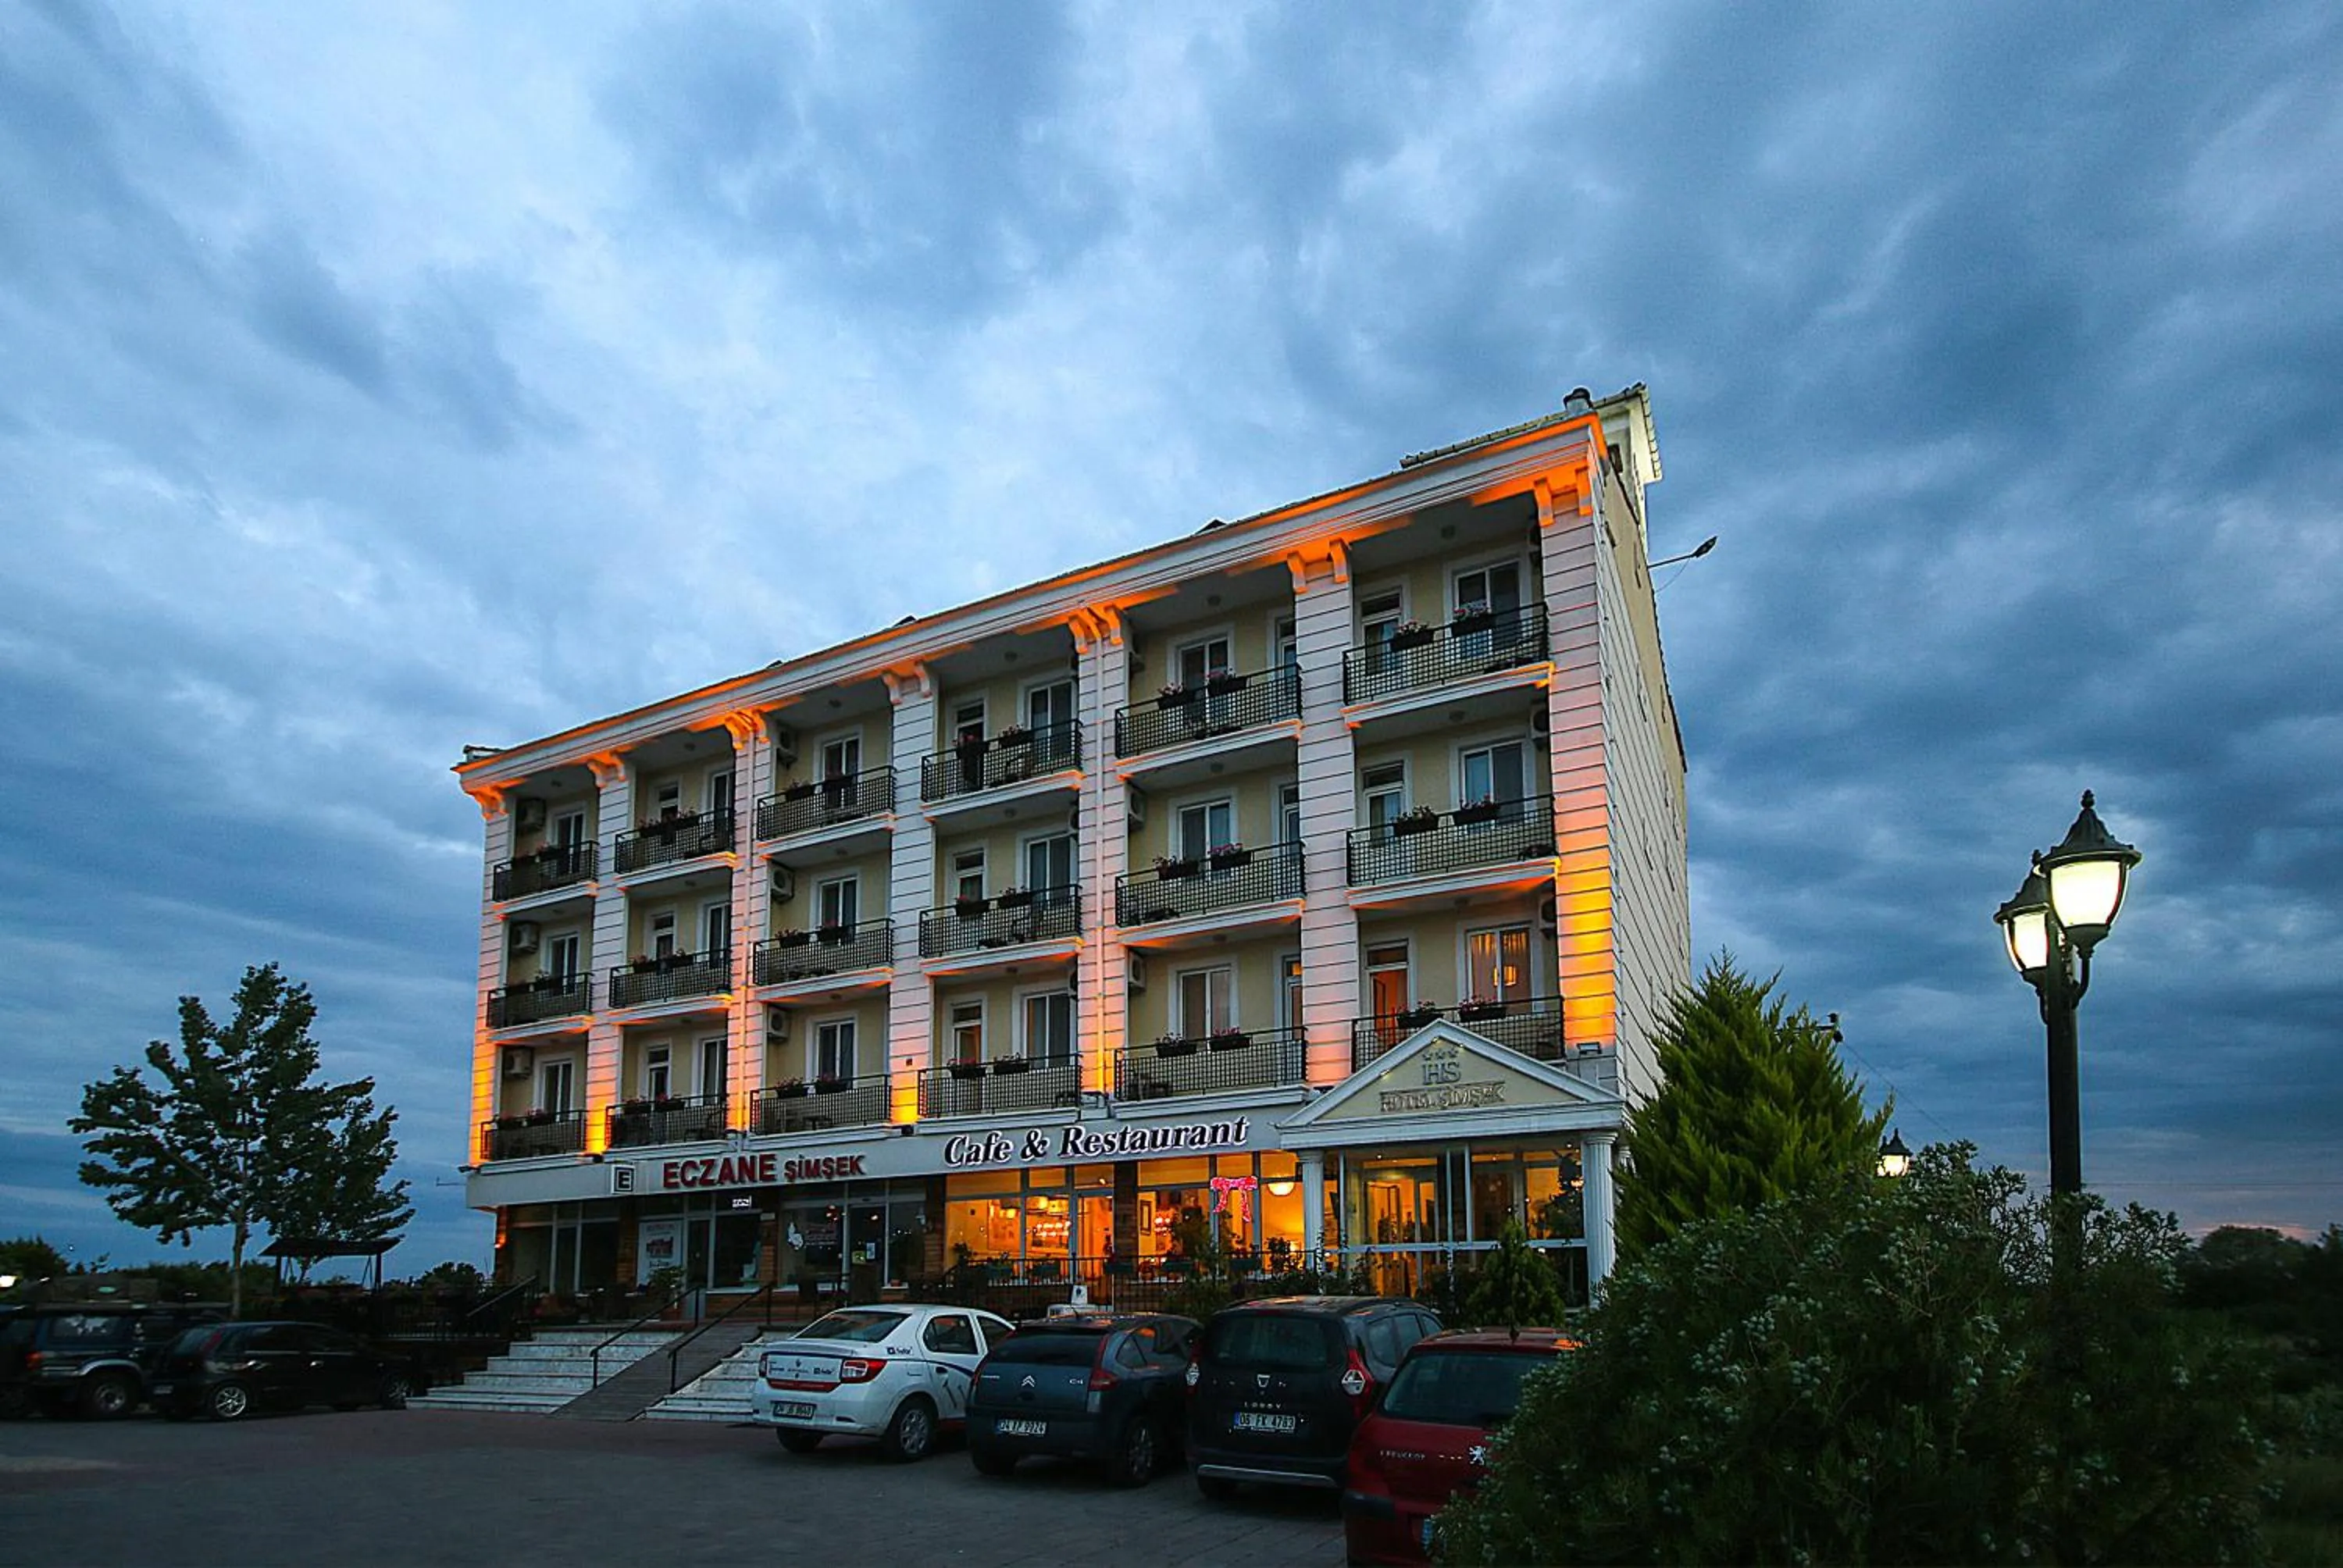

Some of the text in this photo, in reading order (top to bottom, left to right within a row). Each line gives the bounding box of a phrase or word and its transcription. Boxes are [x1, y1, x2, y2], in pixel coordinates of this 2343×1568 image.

[1422, 1061, 1462, 1086] HS
[943, 1115, 1250, 1167] Cafe & Restaurant
[663, 1153, 777, 1189] ECZANE
